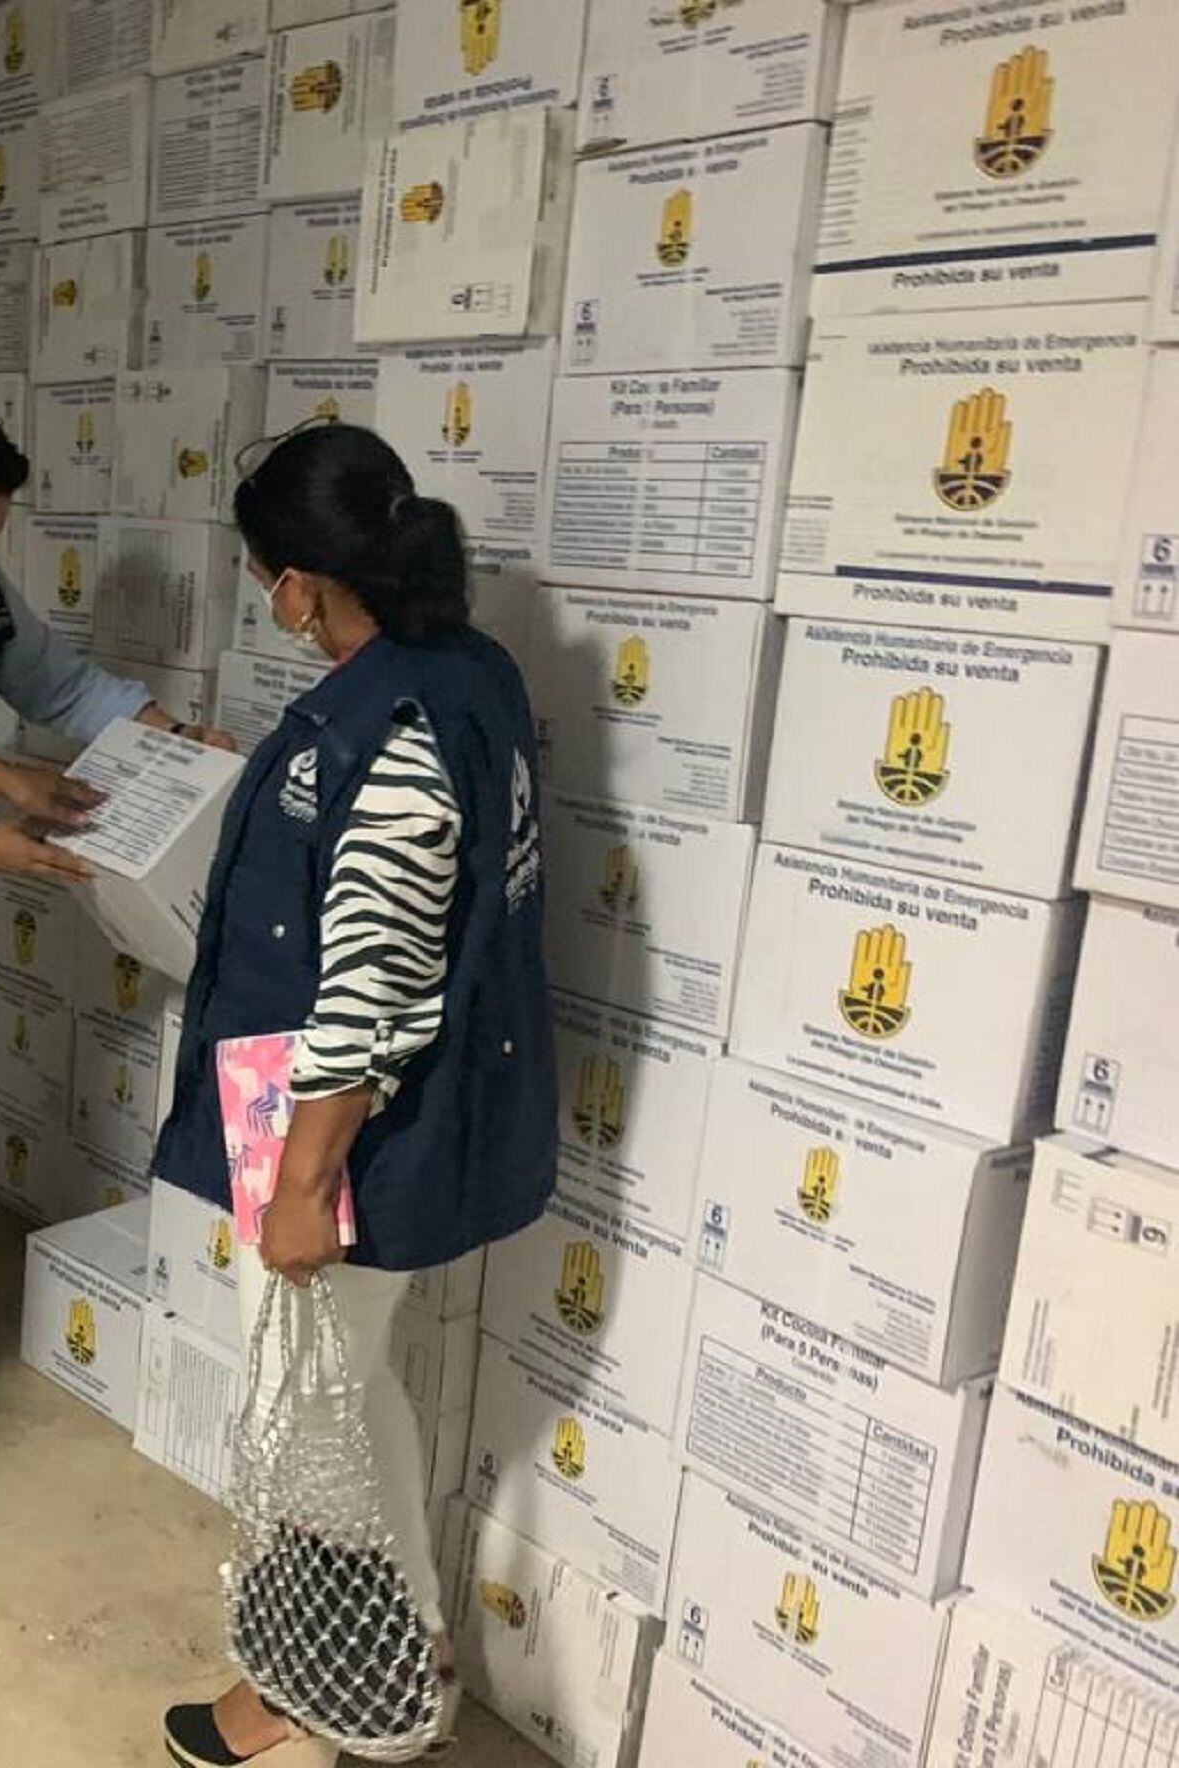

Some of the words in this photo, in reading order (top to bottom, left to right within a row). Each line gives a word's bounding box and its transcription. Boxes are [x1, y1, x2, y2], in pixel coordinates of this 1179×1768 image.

[893, 268, 975, 290] Prohibida
[980, 267, 1004, 282] su
[1009, 261, 1061, 281] venta
[1045, 333, 1138, 354] Emergencia
[899, 357, 990, 376] Prohibida
[995, 360, 1021, 374] su
[1025, 355, 1083, 375] venta
[1153, 537, 1172, 563] 6
[852, 583, 935, 605] Prohibida
[940, 592, 961, 608] su
[967, 595, 1019, 613] venta
[805, 624, 872, 647] Asistencia
[875, 631, 958, 655] Humanitaria
[961, 640, 980, 656] de
[983, 640, 1073, 666] Emergencia
[841, 645, 930, 674] Prohibida
[934, 659, 960, 677] su
[964, 662, 1020, 683] venta
[774, 851, 839, 880] Asistencia
[841, 865, 921, 897] Humanitaria
[923, 885, 941, 901] de
[944, 887, 1030, 921] Emergencia
[808, 876, 893, 913] Prohibida
[897, 901, 921, 918] su
[925, 906, 978, 931] venta
[1092, 1057, 1110, 1081] 6
[771, 1101, 832, 1138] Prohibida
[856, 1137, 893, 1160] venta
[711, 1204, 722, 1225] 6
[810, 1346, 879, 1394] Persnas)
[1055, 1424, 1156, 1489] Prohibida
[747, 1519, 803, 1557] Prohibid
